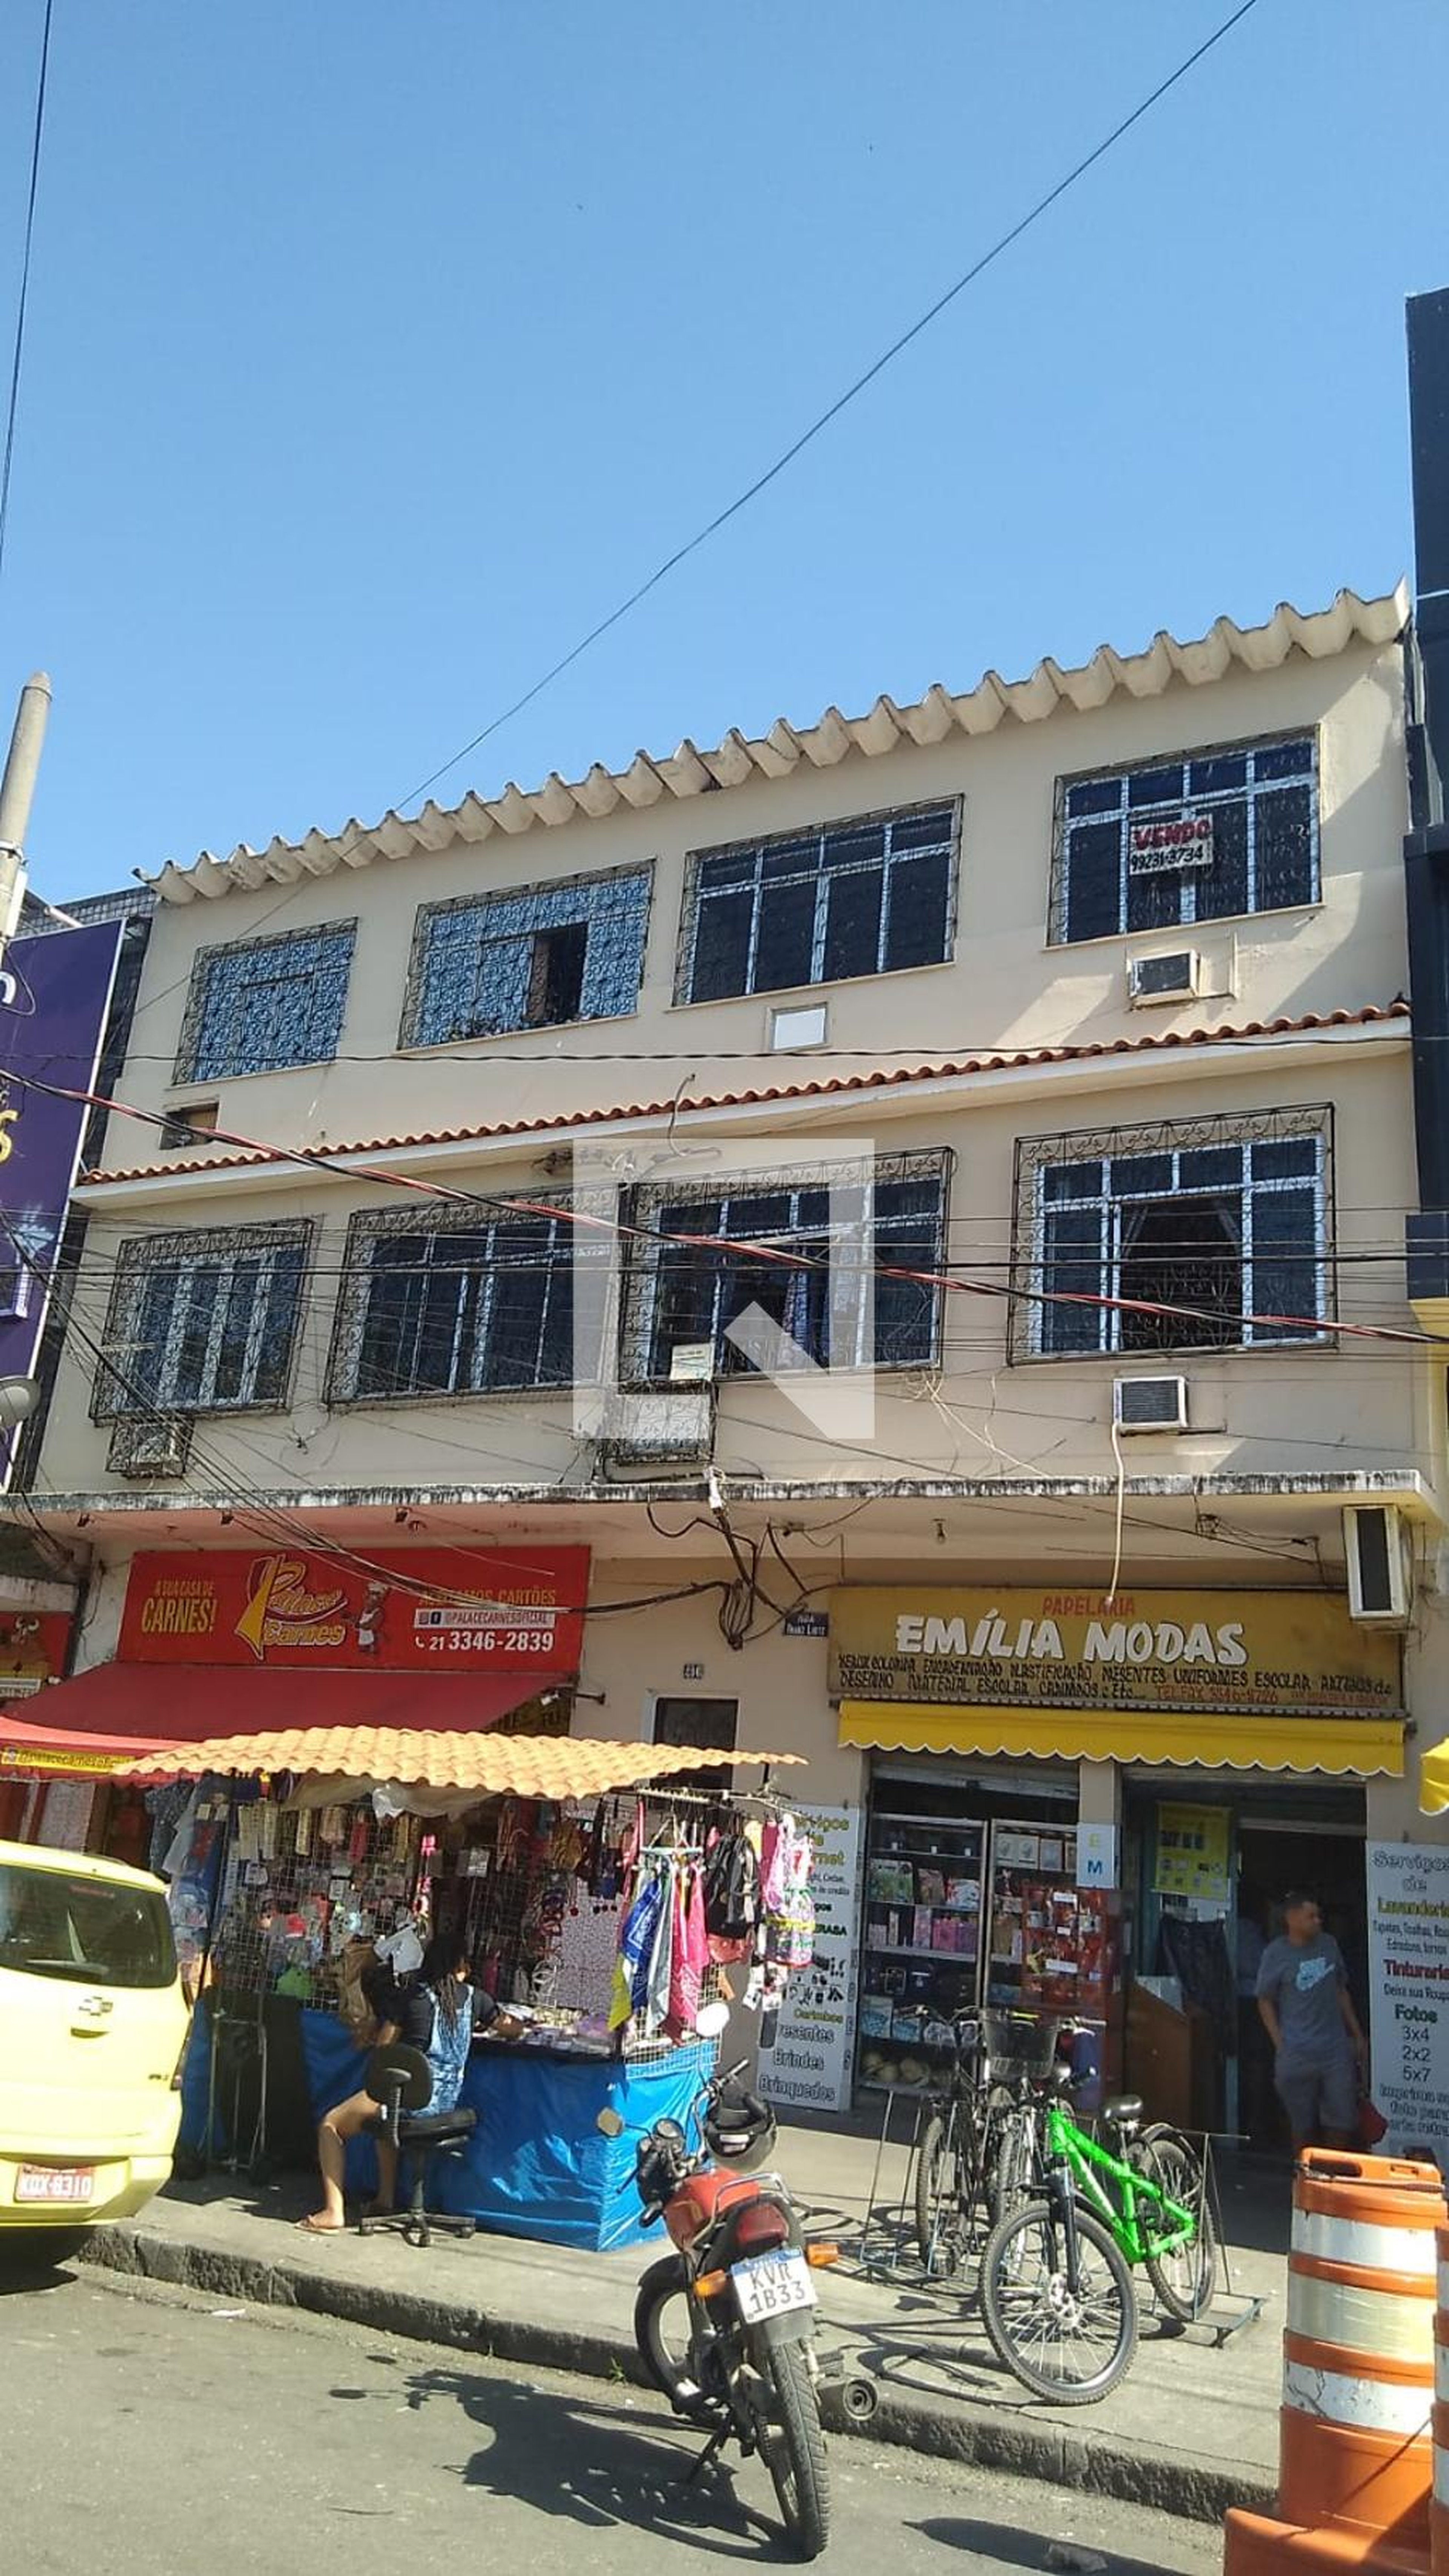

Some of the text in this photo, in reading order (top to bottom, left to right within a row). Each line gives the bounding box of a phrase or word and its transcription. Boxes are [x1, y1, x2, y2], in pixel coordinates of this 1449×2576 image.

[1132, 819, 1211, 850] VENDO
[142, 1598, 217, 1632] CARNES!
[1042, 1595, 1135, 1616] PAPELARIA
[265, 1621, 346, 1646] Carnes
[429, 1631, 554, 1652] 21 3346-2839
[896, 1608, 1248, 1665] EMÍLIA MODAS
[1088, 1860, 1102, 1874] M
[1395, 2003, 1438, 2024] Fotos
[1403, 2025, 1429, 2042] 3x4
[774, 2049, 824, 2071] Brindes
[1403, 2045, 1432, 2063] 2x2
[1403, 2064, 1432, 2082] 5x7
[758, 2074, 836, 2101] Brinquedos
[750, 2263, 793, 2290] KVR
[750, 2281, 805, 2314] 1B33
